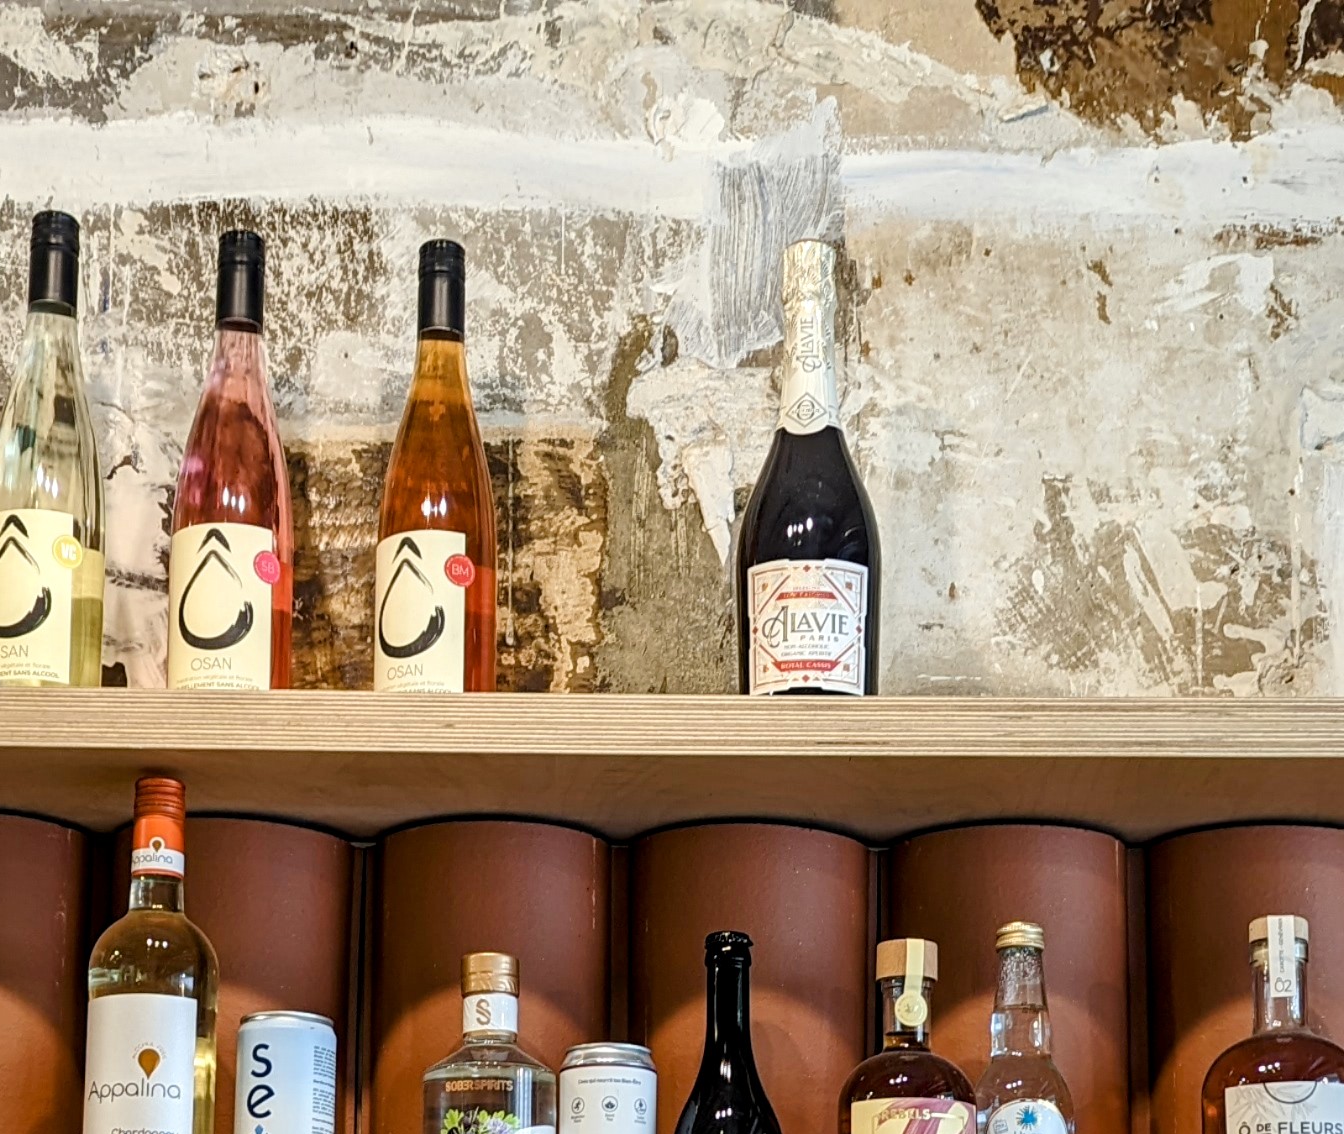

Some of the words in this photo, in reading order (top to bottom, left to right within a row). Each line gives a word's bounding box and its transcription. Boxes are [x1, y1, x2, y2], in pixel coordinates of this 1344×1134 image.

[451, 564, 470, 578] BM
[762, 604, 849, 649] ALAVIE
[190, 657, 232, 671] OSAN
[387, 663, 424, 681] OSAN
[88, 1077, 181, 1105] Appalina
[1256, 1122, 1272, 1134] DE
